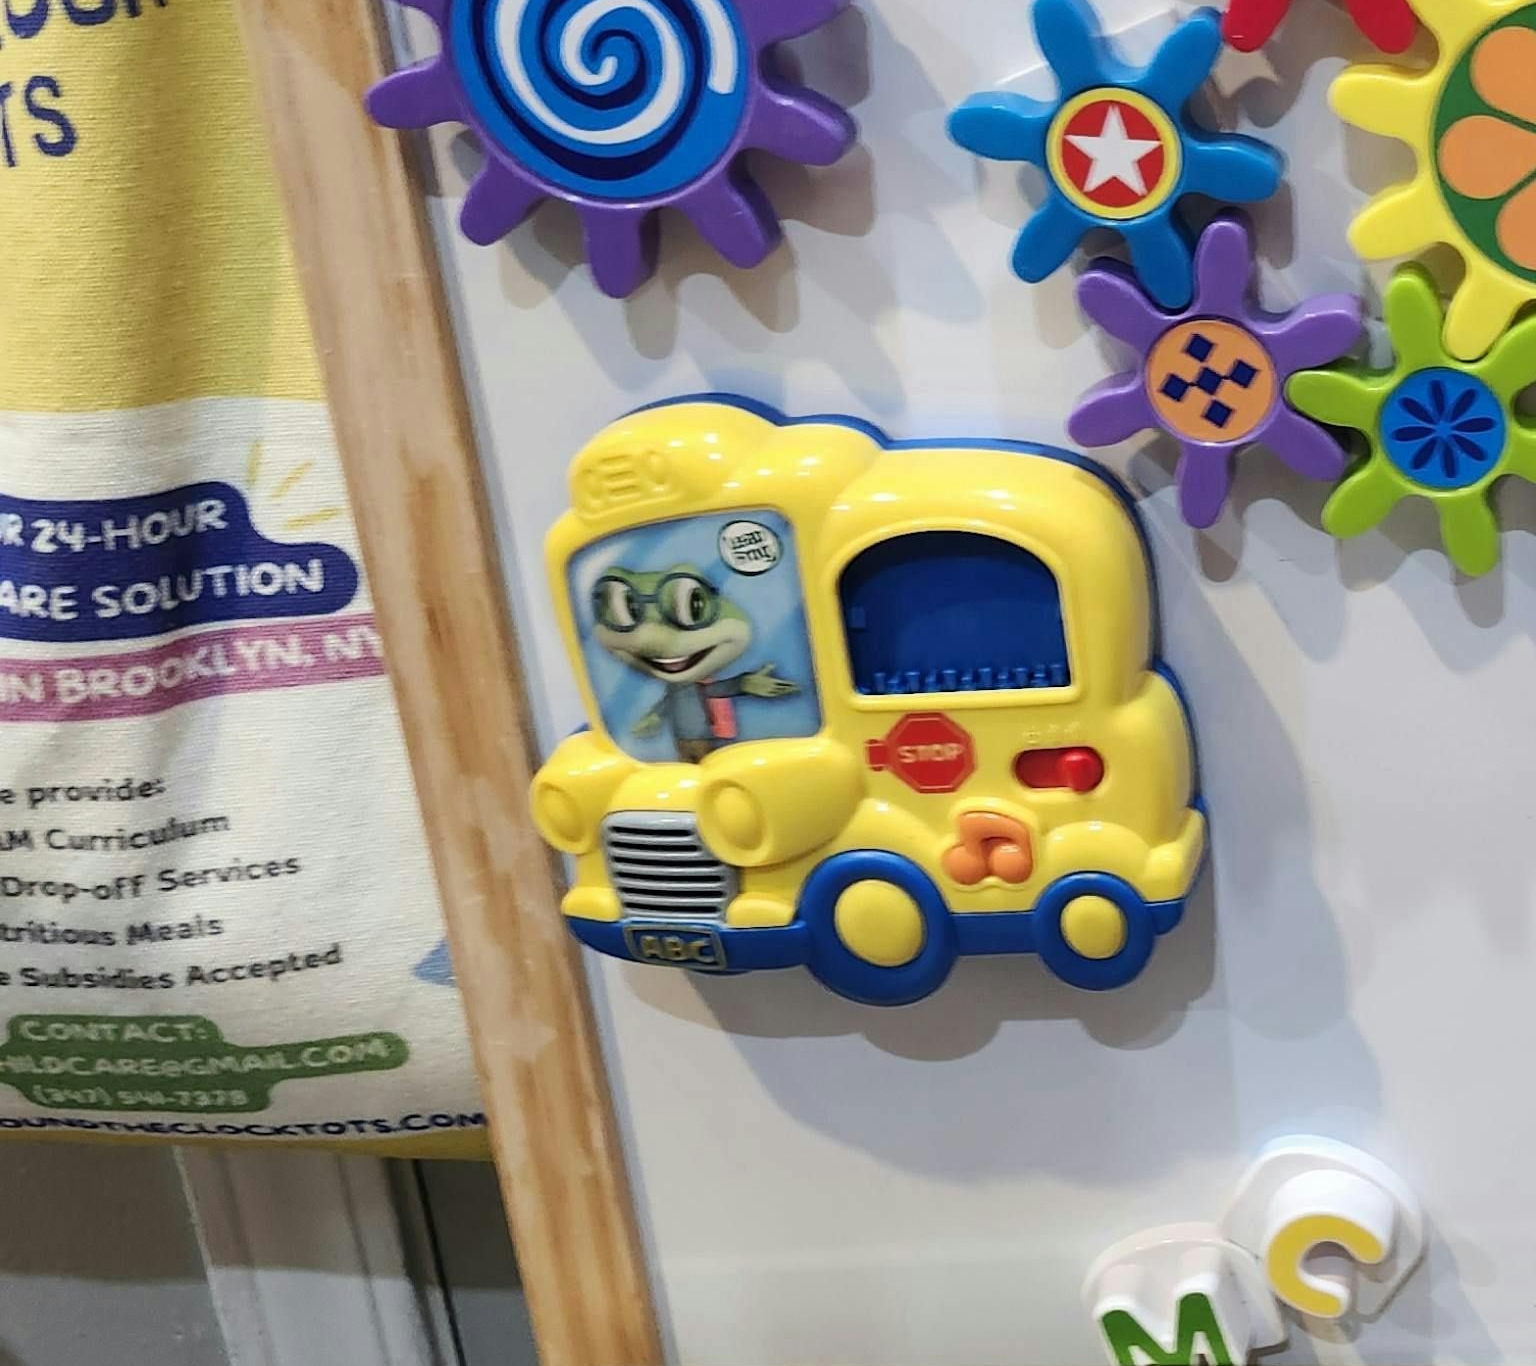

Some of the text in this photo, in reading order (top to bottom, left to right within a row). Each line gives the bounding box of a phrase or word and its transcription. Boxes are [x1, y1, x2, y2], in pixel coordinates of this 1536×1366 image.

[31, 498, 228, 554] 24-HOUR
[91, 558, 326, 620] SOLUTION
[897, 743, 966, 764] STOP
[45, 815, 231, 852] Curriculum
[158, 856, 302, 892] Services
[126, 914, 224, 947] Meals
[185, 942, 344, 983] Accepted
[1267, 1214, 1386, 1318] C
